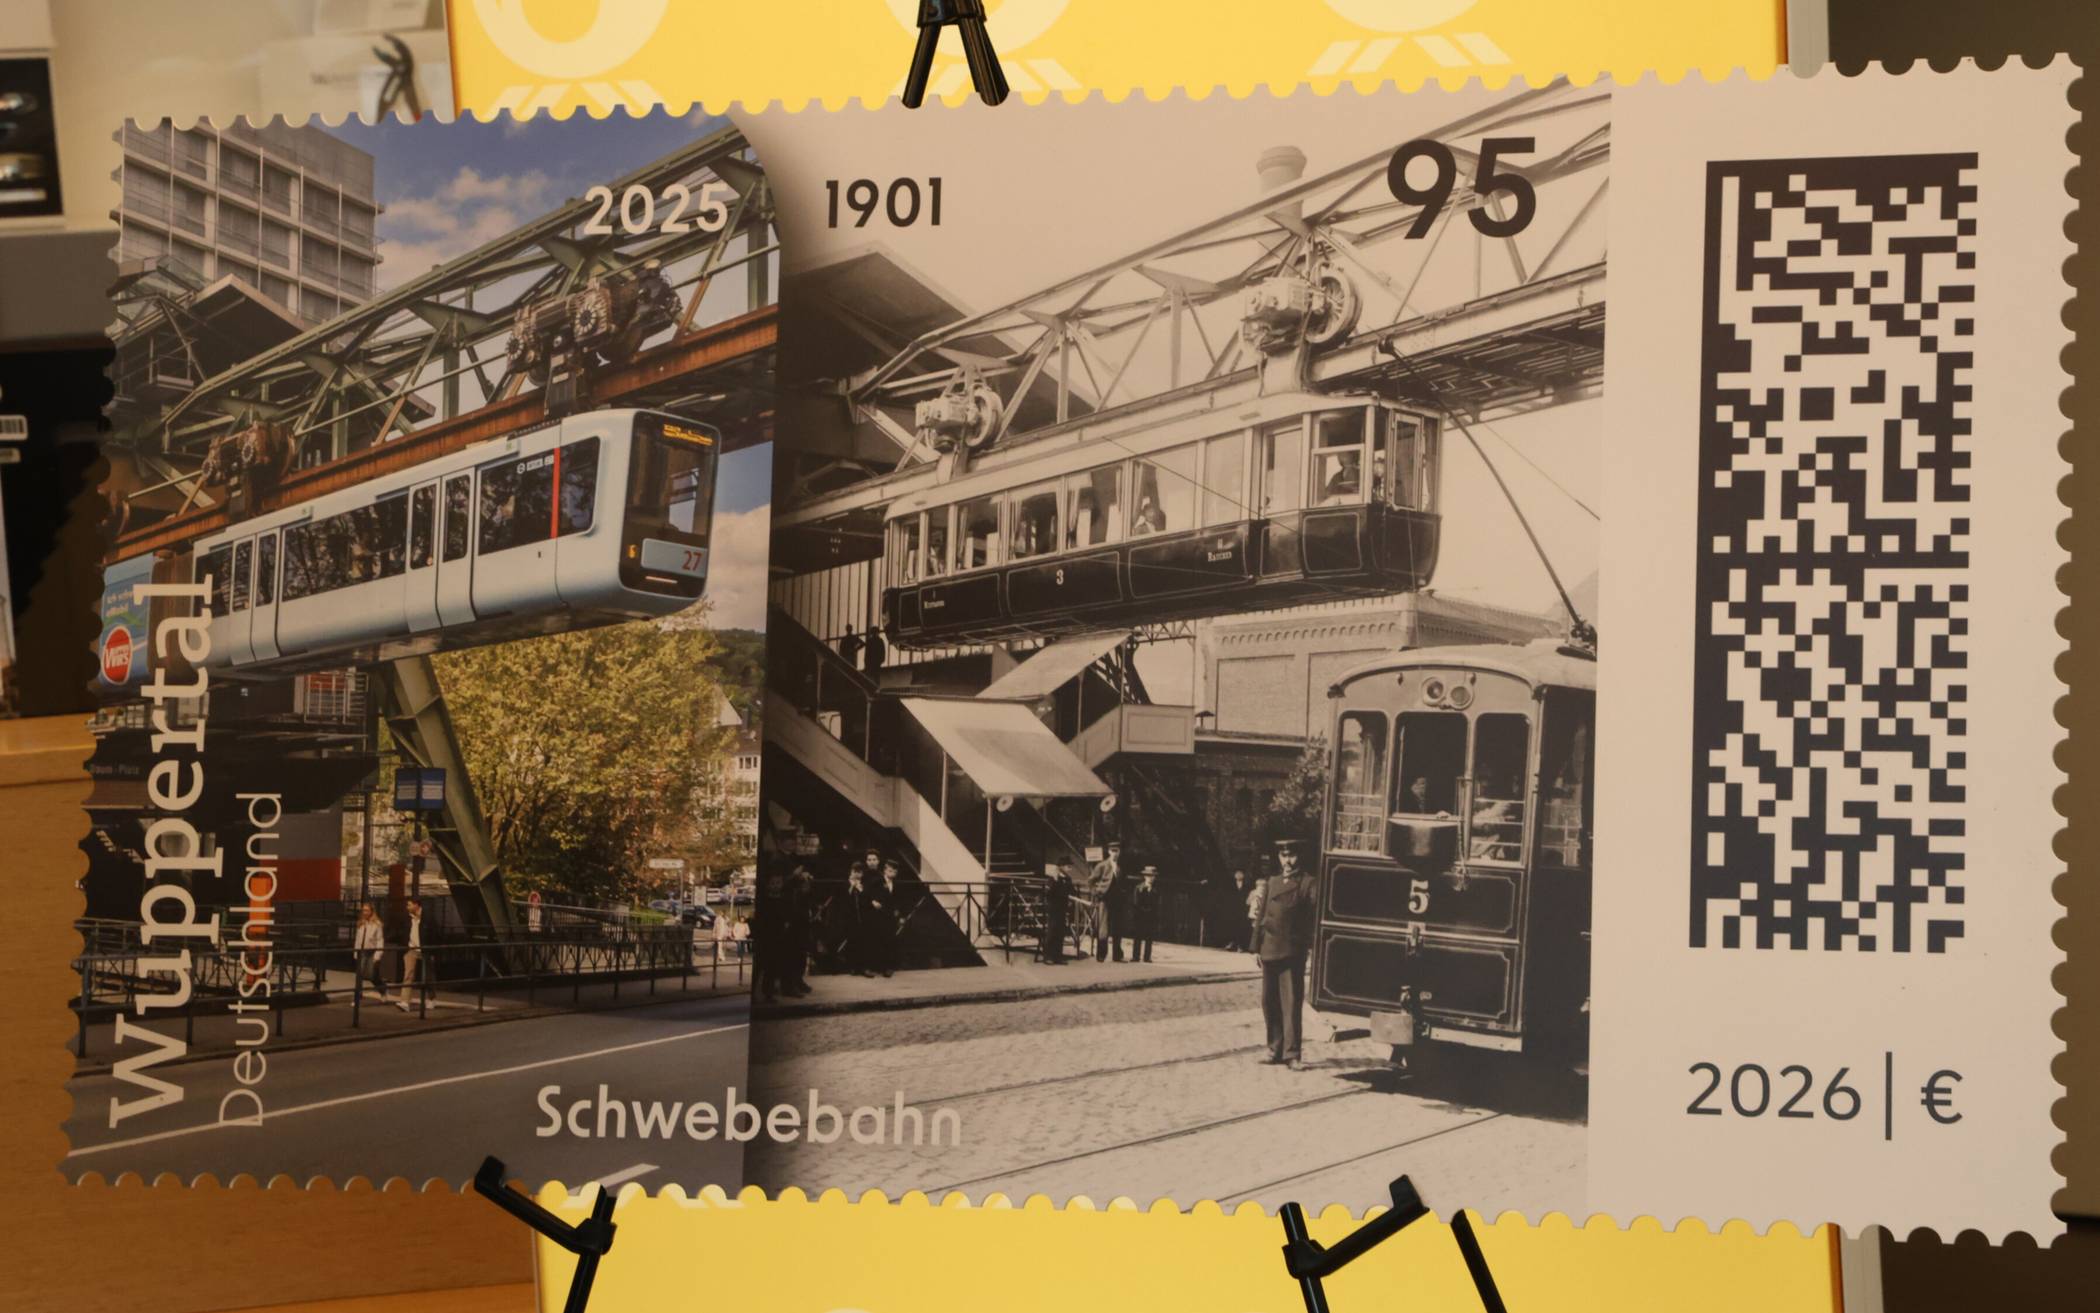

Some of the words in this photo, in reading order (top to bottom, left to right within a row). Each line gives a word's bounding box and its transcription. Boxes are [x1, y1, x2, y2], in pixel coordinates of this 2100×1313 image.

[584, 182, 730, 235] 2025
[825, 177, 942, 228] 1901
[1387, 137, 1535, 239] 95
[683, 550, 702, 571] 27
[1056, 569, 1064, 585] 3
[109, 574, 223, 1128] Wuppertal
[1409, 879, 1430, 914] 5
[217, 792, 282, 1126] Deutschland
[535, 1083, 962, 1147] Schwebebahn
[1686, 1062, 1862, 1121] 2026
[1920, 1069, 1965, 1124] €
